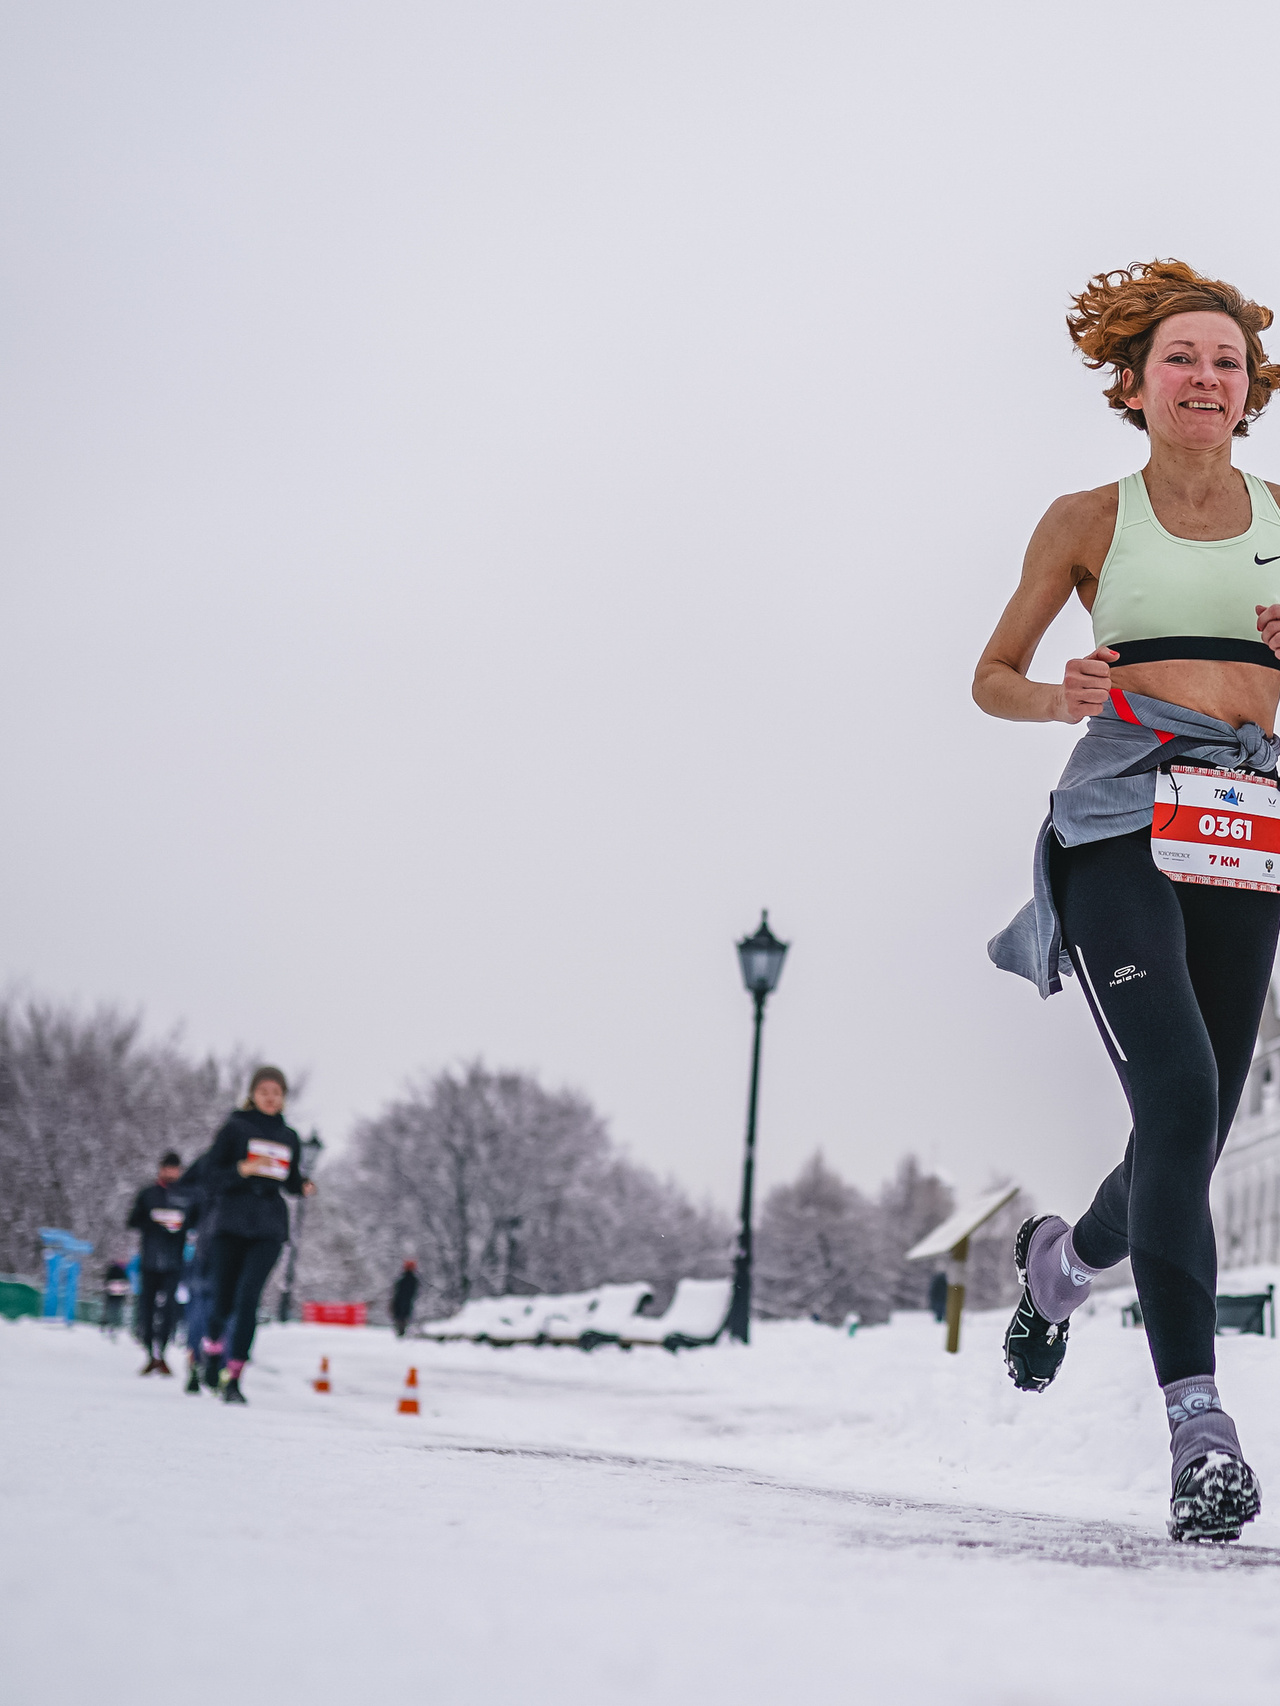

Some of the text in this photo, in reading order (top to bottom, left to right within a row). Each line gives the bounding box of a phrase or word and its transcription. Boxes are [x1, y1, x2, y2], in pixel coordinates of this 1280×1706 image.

[1214, 788, 1245, 805] TRAIL
[1198, 814, 1252, 841] 0361
[1209, 855, 1218, 866] 7
[1190, 1398, 1205, 1411] G
